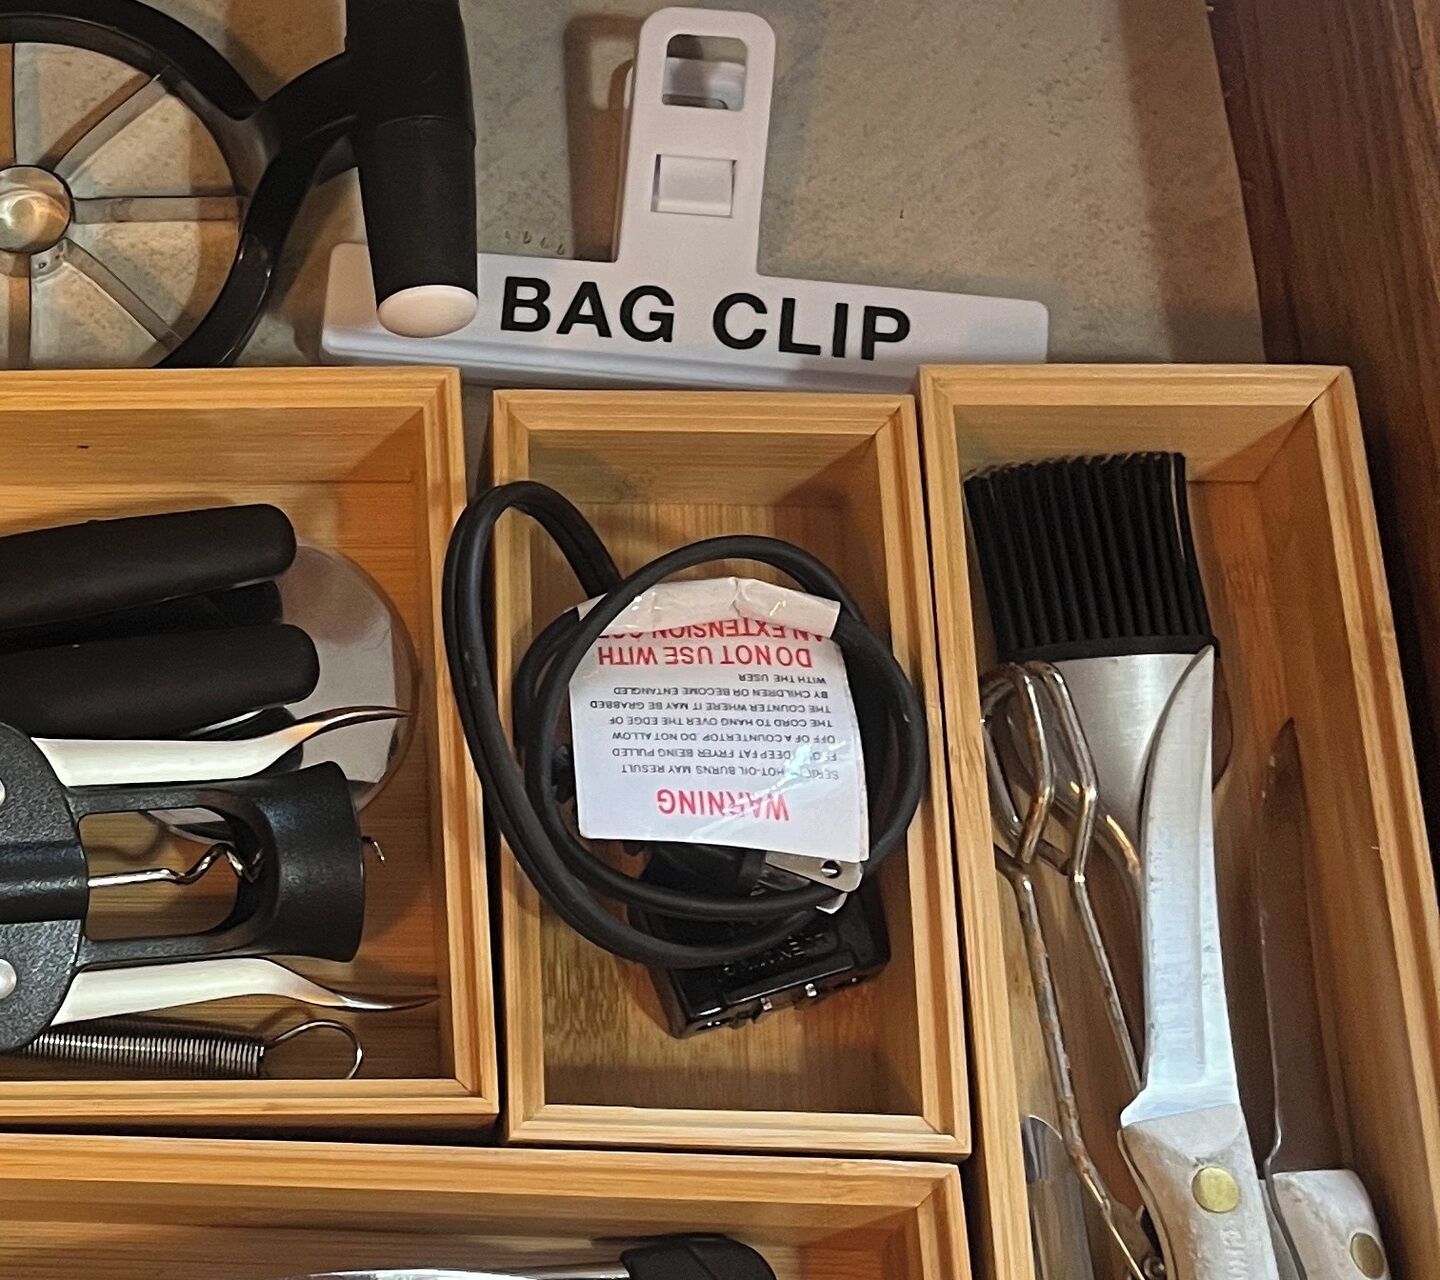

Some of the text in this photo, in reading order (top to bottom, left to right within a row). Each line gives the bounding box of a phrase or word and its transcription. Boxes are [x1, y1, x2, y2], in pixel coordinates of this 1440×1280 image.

[499, 275, 911, 362] BAG CLIP
[597, 645, 813, 668] DO NOT USE WITH
[738, 673, 827, 685] WITH THE USER
[613, 687, 828, 699] BY CHILDREN OR BECOME ENTANGLED
[590, 700, 831, 714] THE COUNTER WHERE IT MAY BE GRABBED
[608, 716, 833, 728] THE CORD TO HANG OVER THE EDGE OF
[612, 732, 652, 741] ALLOW
[654, 733, 678, 741] NOT
[680, 733, 697, 741] DO
[784, 735, 792, 743] A
[794, 734, 810, 743] OF
[814, 735, 836, 744] OFF
[611, 748, 655, 757] PULLED
[658, 748, 693, 758] BEING
[697, 748, 734, 759] FRYER
[738, 749, 758, 759] FAT
[760, 750, 791, 760] DEEP
[621, 764, 665, 774] RESULT
[667, 765, 691, 775] MAY
[696, 765, 736, 776] BURNS
[738, 766, 785, 777] HOT-OIL
[656, 788, 789, 822] WARNING
